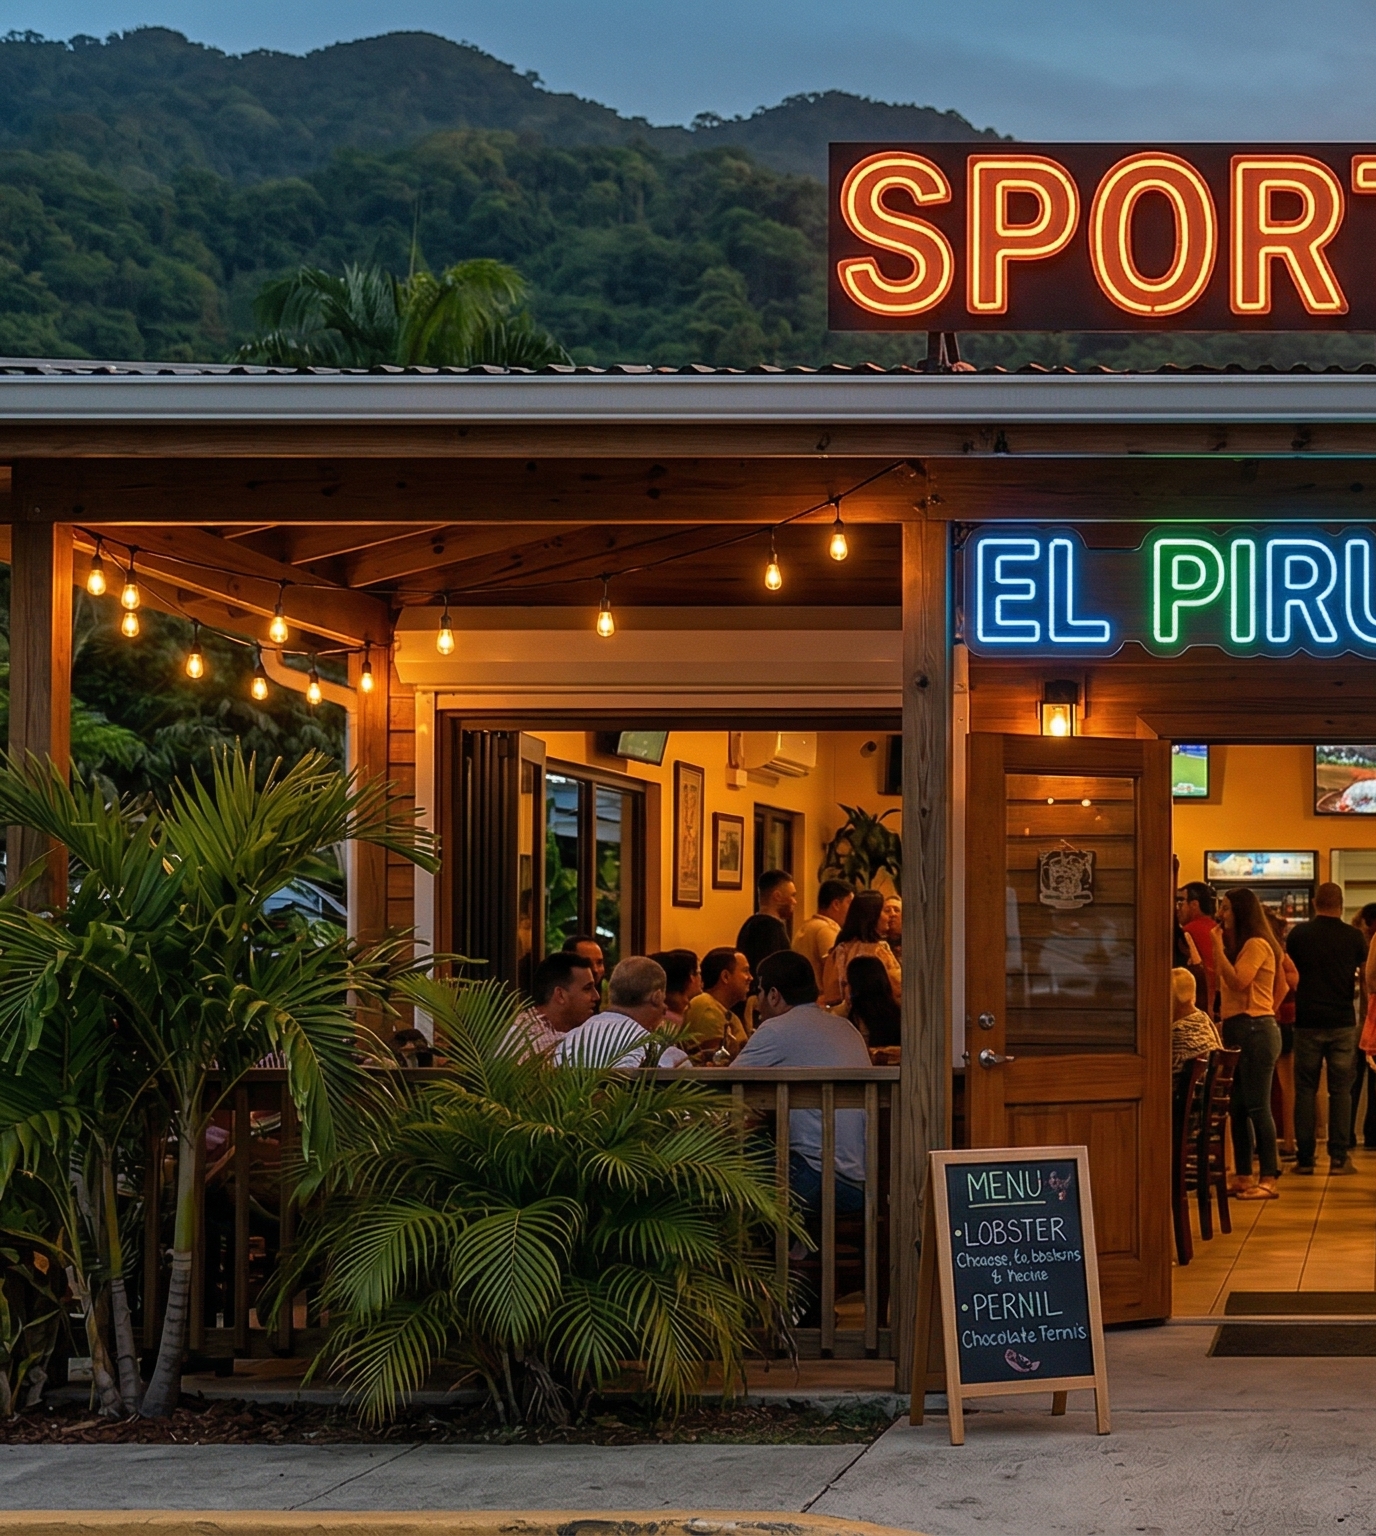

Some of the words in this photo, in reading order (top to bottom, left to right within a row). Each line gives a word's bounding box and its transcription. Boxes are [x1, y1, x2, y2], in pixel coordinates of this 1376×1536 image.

[975, 537, 1111, 644] EL
[967, 1170, 1042, 1202] MENU
[964, 1217, 1067, 1247] LOBSTER
[973, 1291, 1063, 1321] PERNIL
[962, 1327, 1037, 1349] Chocolate
